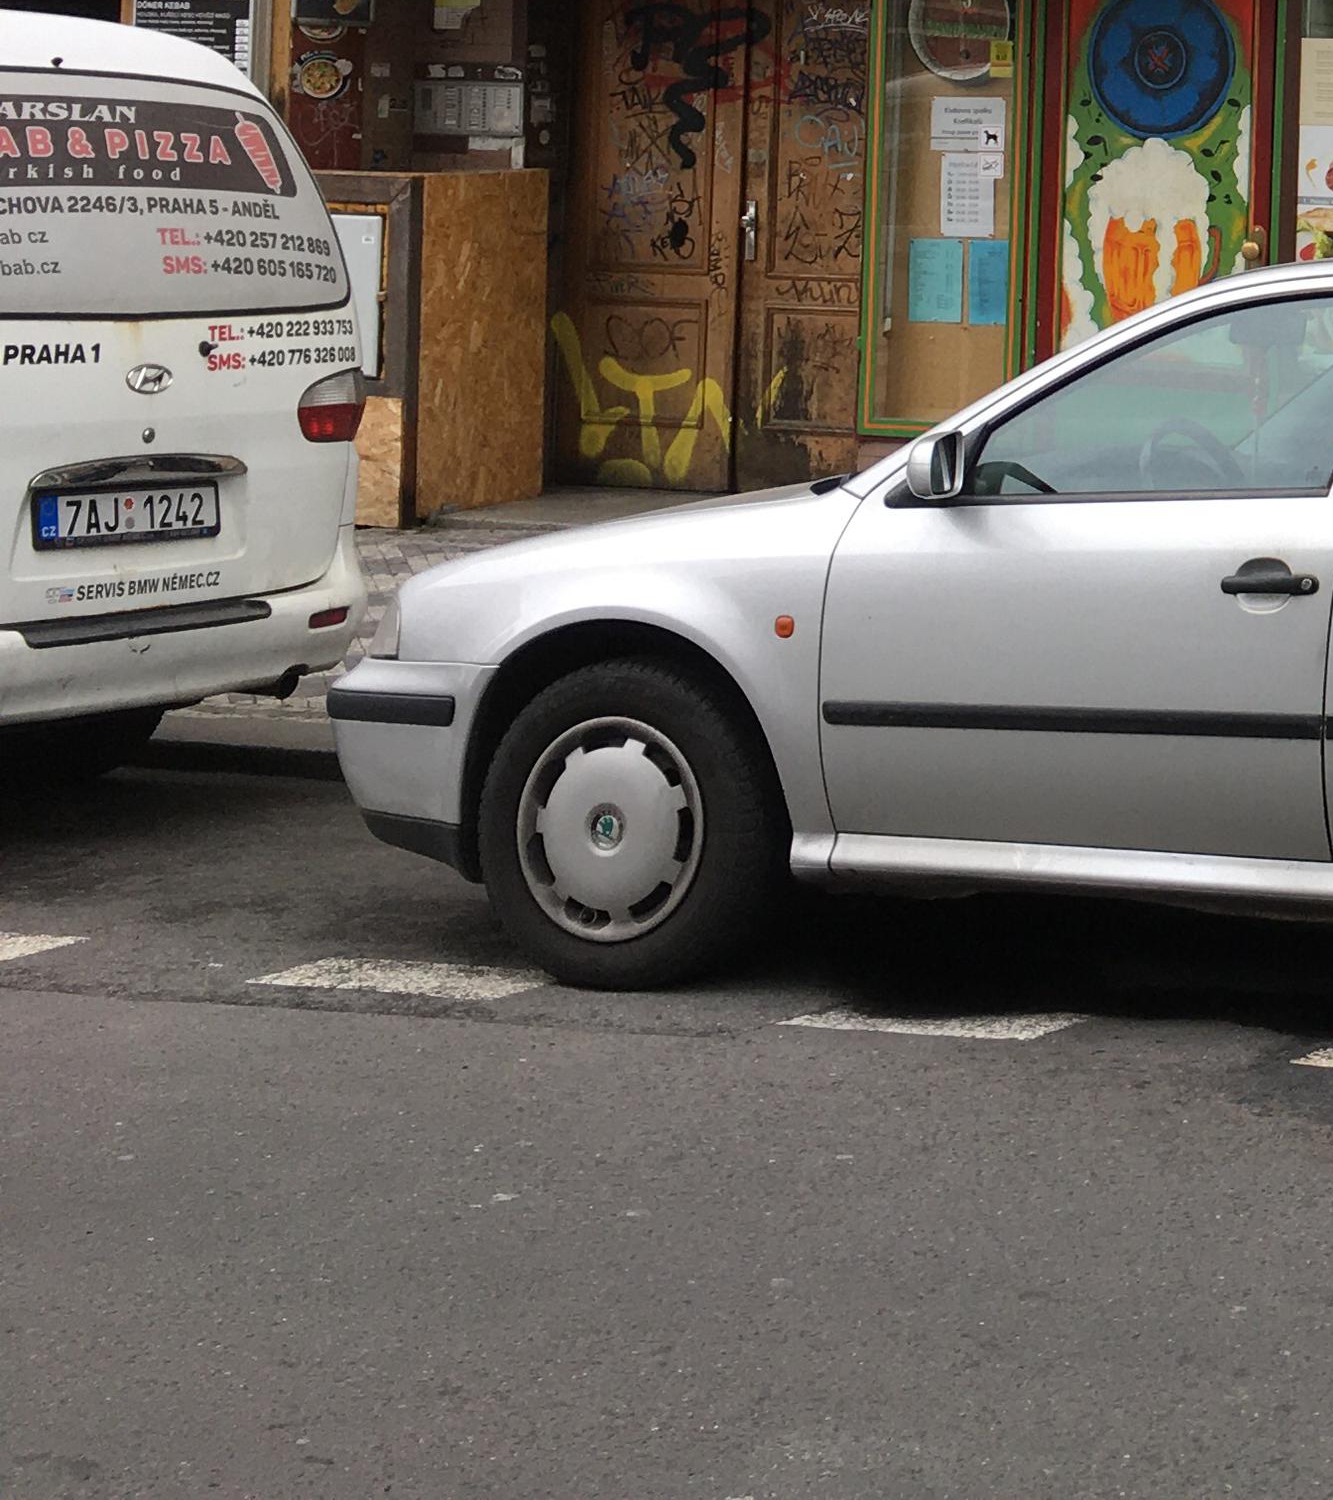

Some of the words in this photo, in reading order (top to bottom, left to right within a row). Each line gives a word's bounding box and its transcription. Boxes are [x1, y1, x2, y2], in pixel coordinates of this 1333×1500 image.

[164, 1, 191, 10] KEBAB
[0, 101, 137, 124] ARSLAN
[66, 126, 96, 159] &
[104, 127, 232, 166] PIZZA
[118, 164, 181, 182] food
[67, 196, 144, 216] 2246/3,
[147, 196, 207, 215] PRAHA
[209, 199, 220, 215] 5
[231, 199, 280, 221] ANDĚL
[204, 230, 246, 248] +420
[249, 231, 278, 249] 257
[280, 235, 305, 252] 212
[307, 237, 331, 257] 869
[162, 255, 207, 275] SMS:
[211, 257, 253, 276] +420
[256, 260, 286, 278] 605
[288, 260, 313, 280] 165
[315, 265, 337, 284] 720
[247, 322, 284, 339] +420
[286, 321, 310, 338] 222
[312, 320, 334, 336] 933
[336, 319, 354, 335] 753
[3, 344, 87, 366] PRAHA
[90, 343, 102, 364] 1
[207, 352, 245, 372] SMS:
[249, 349, 285, 367] +420
[287, 348, 311, 365] 776
[314, 348, 336, 364] 326
[65, 495, 120, 536] 7AJ
[143, 493, 206, 530] 1242
[41, 524, 58, 539] CZ
[76, 580, 125, 602] SERVIS
[127, 577, 161, 597] BMW
